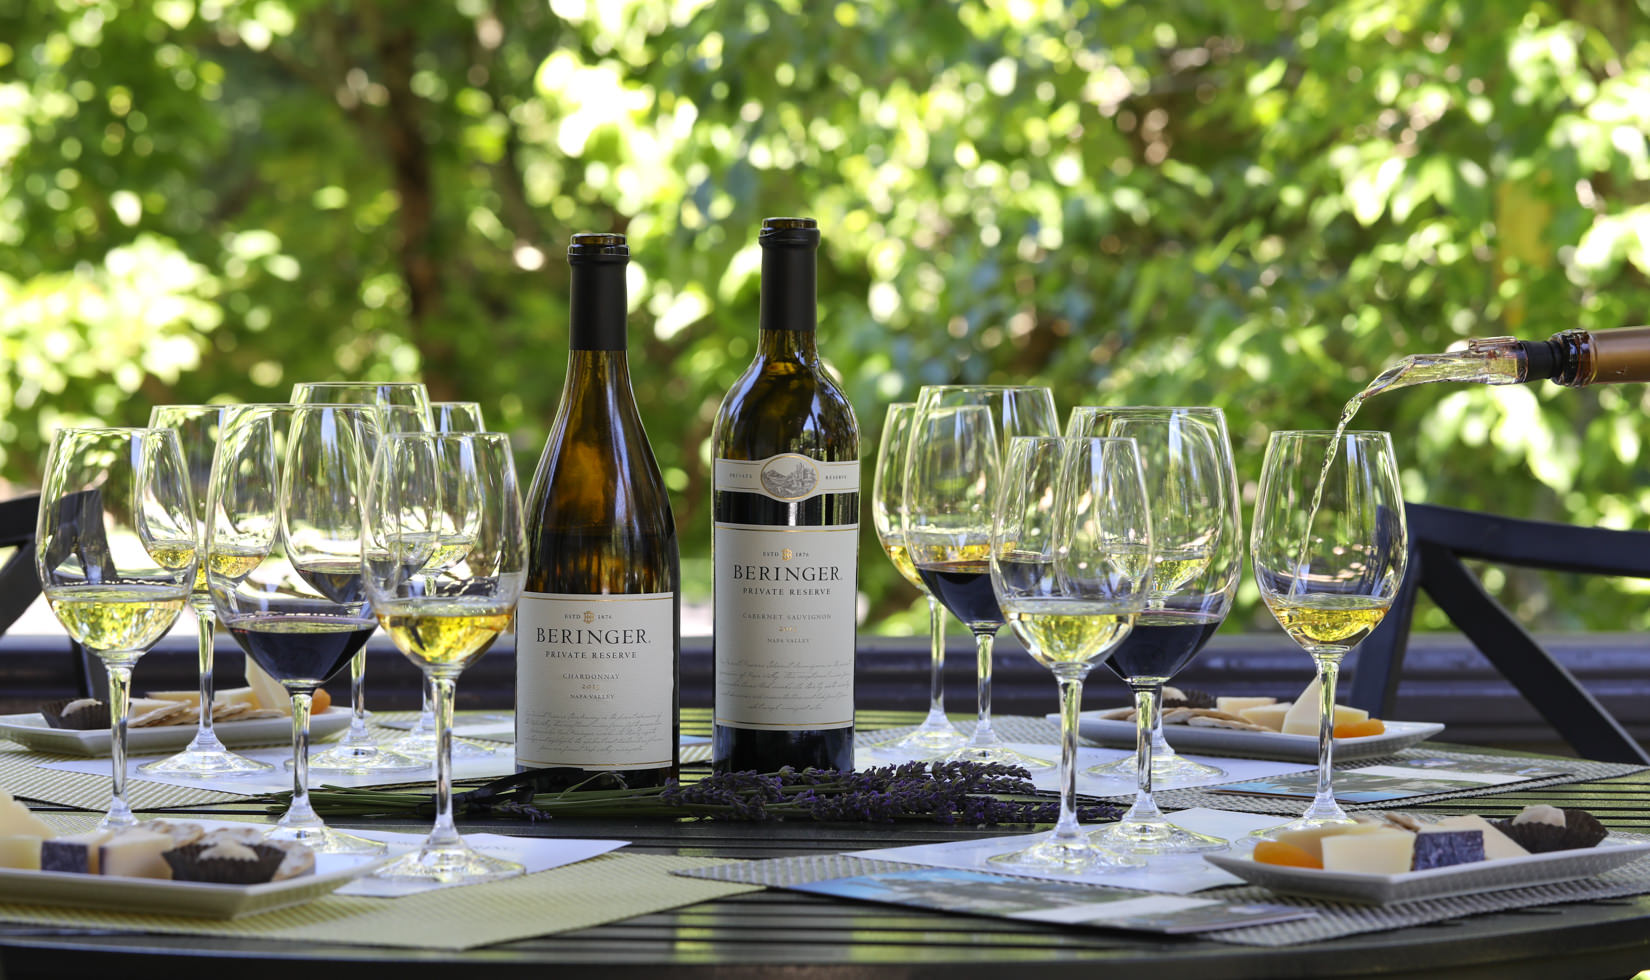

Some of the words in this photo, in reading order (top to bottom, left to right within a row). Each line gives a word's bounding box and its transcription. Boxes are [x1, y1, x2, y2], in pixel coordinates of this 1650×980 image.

[733, 564, 841, 581] BERINGER
[743, 588, 784, 596] PRIVATE
[789, 588, 831, 596] RESERVE
[742, 612, 783, 621] CABERNET
[787, 613, 832, 621] SAUVIGNON
[536, 627, 648, 645] BERINGER
[545, 651, 587, 659] PRIVATE
[591, 652, 637, 660] RESERVE
[562, 673, 621, 681] CHARDONNAY
